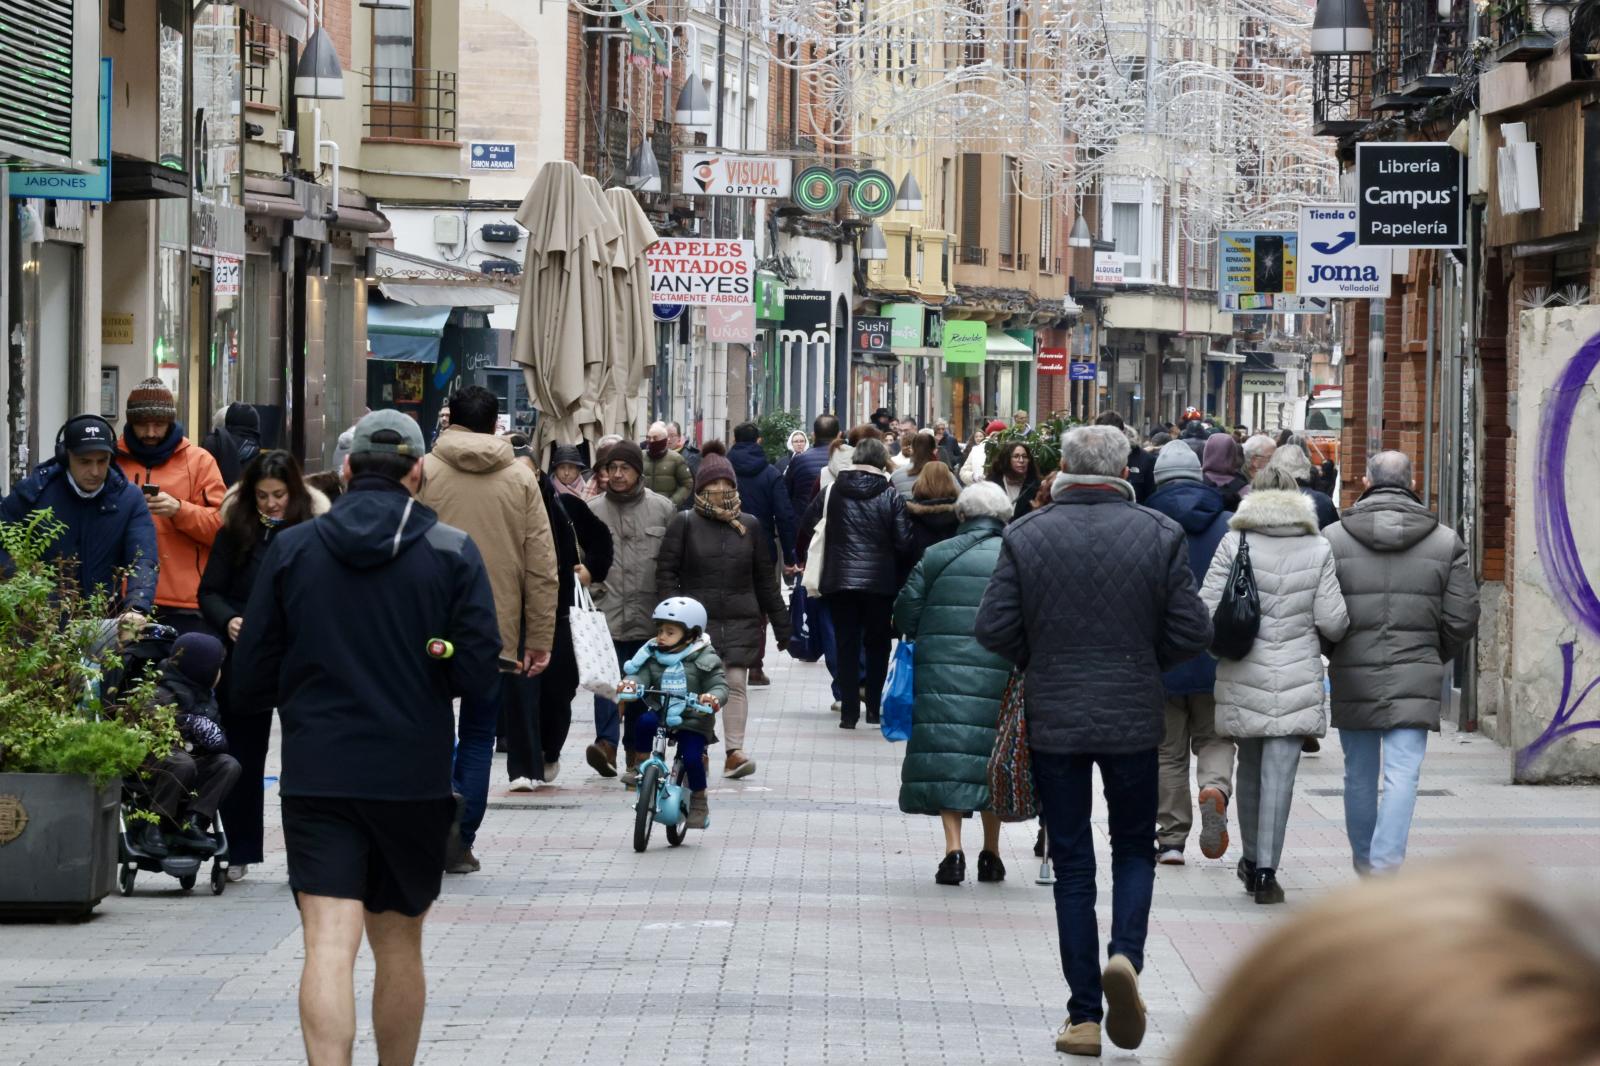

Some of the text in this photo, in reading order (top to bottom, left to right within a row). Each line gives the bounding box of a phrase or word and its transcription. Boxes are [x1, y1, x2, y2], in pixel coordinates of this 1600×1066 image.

[1379, 158, 1440, 174] Librería
[725, 160, 778, 186] VISUAL
[24, 175, 87, 188] JABONES
[726, 186, 778, 195] OPTICA
[1309, 210, 1345, 220] Tienda
[1371, 221, 1448, 237] Papelería
[645, 241, 742, 257] PAPELES
[1339, 283, 1380, 292] Valladolid
[712, 324, 747, 337] UÑAS
[857, 320, 889, 332] Sushi
